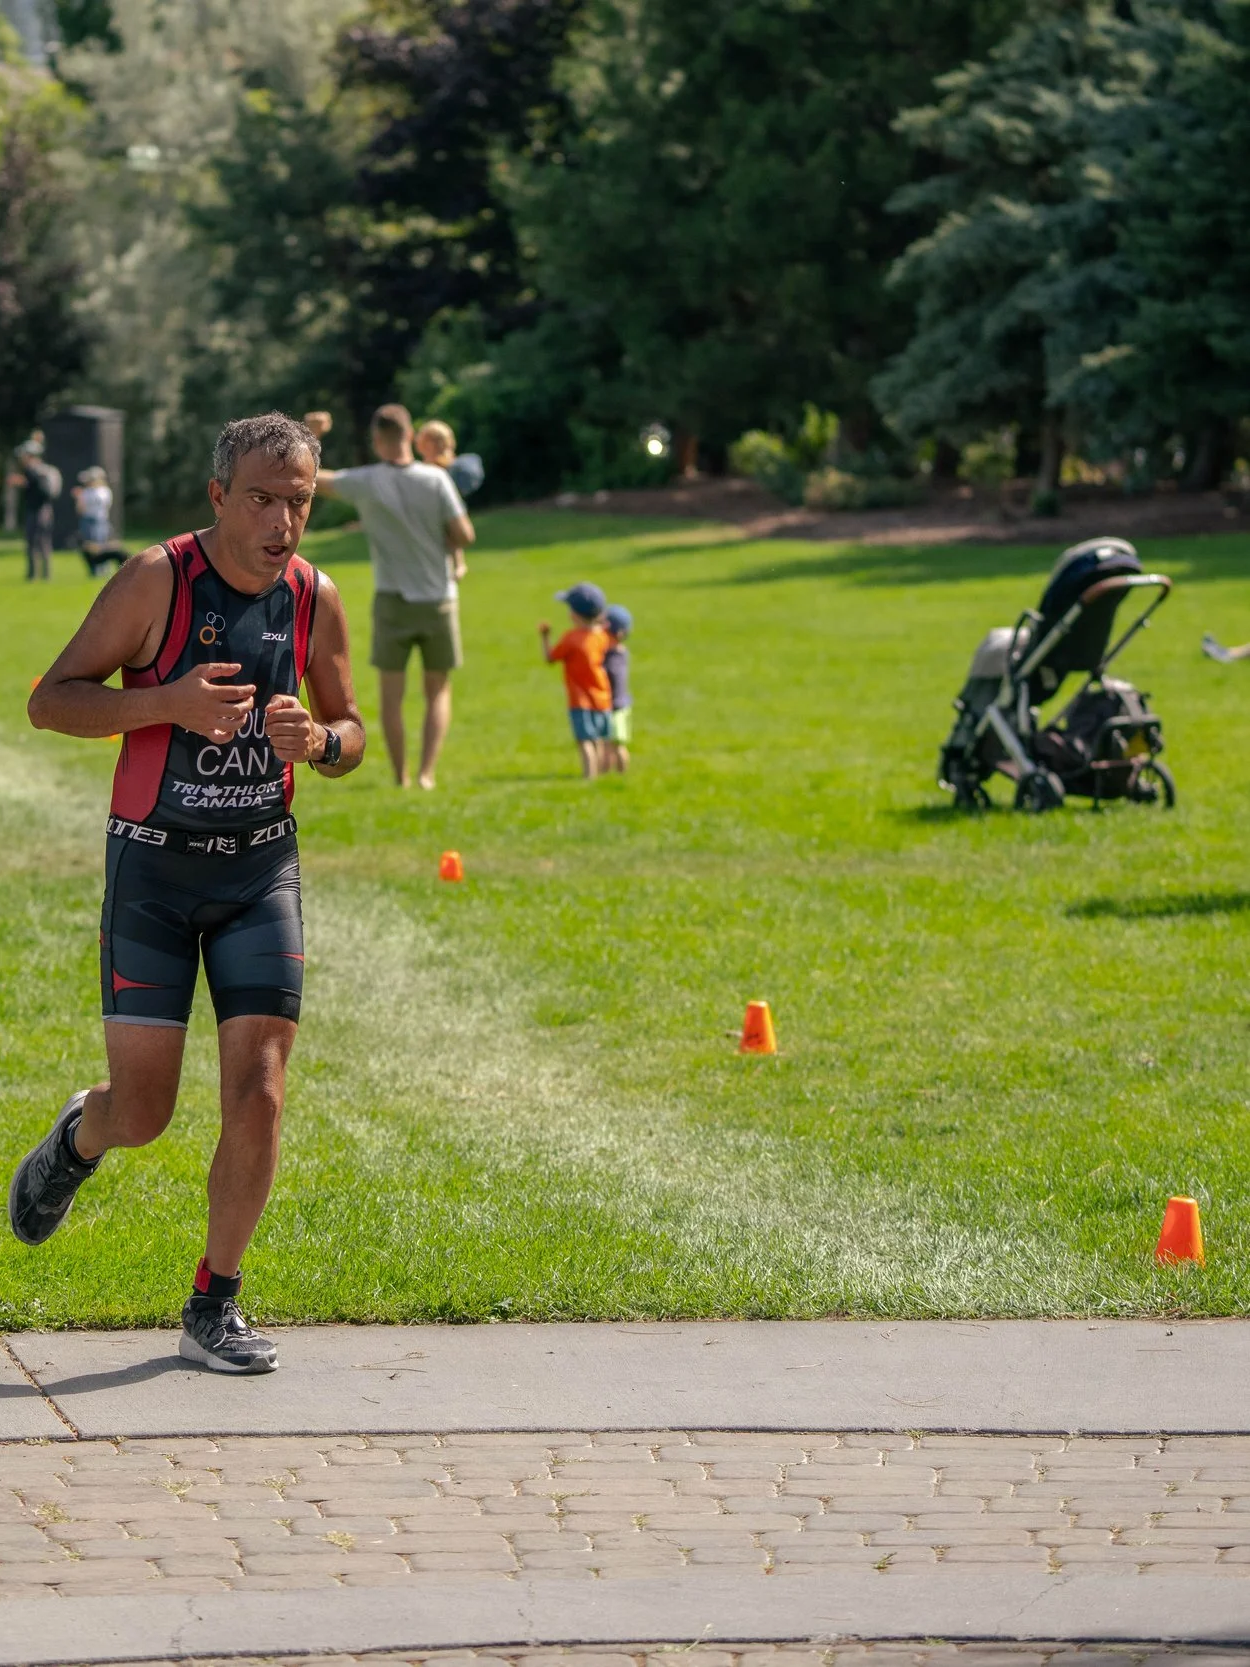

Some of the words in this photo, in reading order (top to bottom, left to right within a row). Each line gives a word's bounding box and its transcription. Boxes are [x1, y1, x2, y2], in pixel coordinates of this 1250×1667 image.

[261, 632, 287, 642] 2XU
[196, 745, 269, 776] CAN
[181, 795, 264, 808] CANADA
